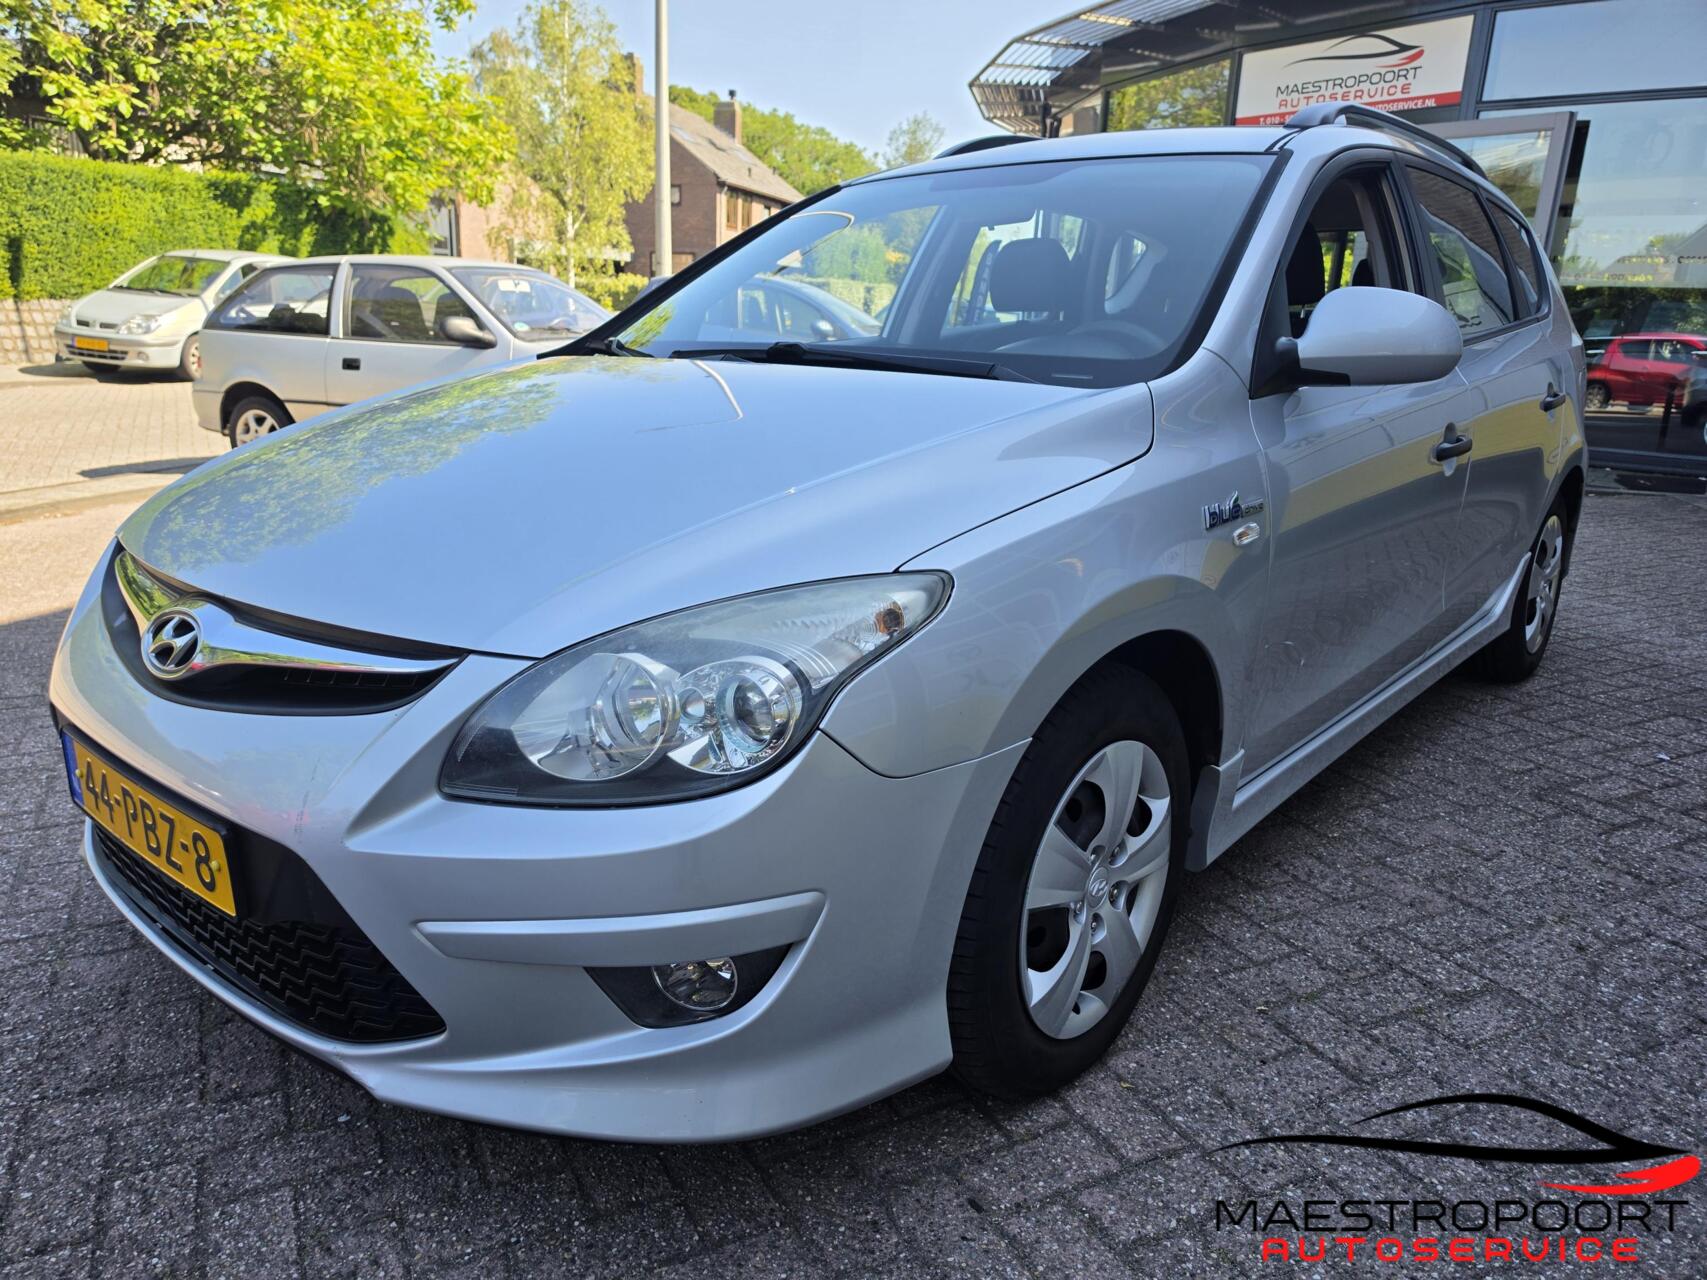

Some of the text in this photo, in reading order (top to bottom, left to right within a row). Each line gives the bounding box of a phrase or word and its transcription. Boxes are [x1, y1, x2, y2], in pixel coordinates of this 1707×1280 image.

[1275, 66, 1422, 98] MAESTROPOORT
[1278, 83, 1412, 110] AUTOSERVICE
[84, 757, 217, 893] 44-PBZ-8
